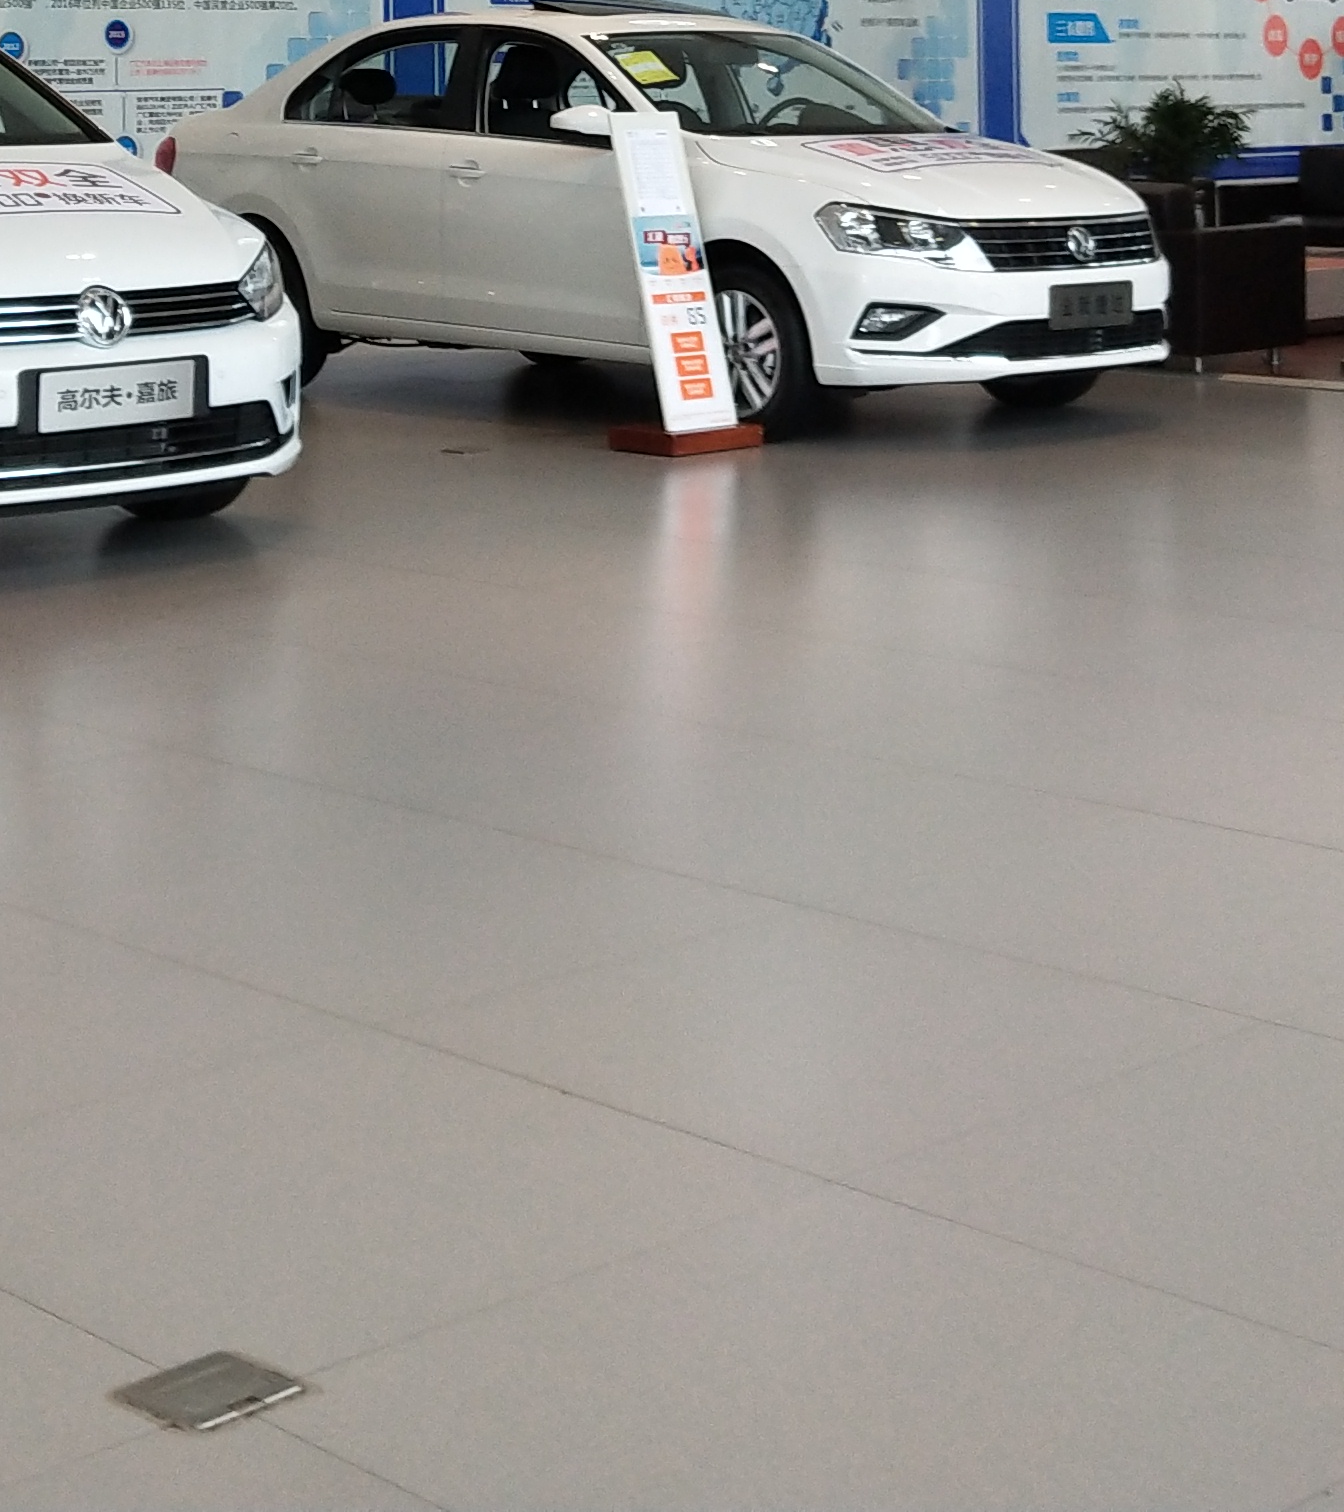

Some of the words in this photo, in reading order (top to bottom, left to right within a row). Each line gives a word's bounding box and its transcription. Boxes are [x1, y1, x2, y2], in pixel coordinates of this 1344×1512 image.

[56, 379, 178, 413] 高尔夫·嘉旅
